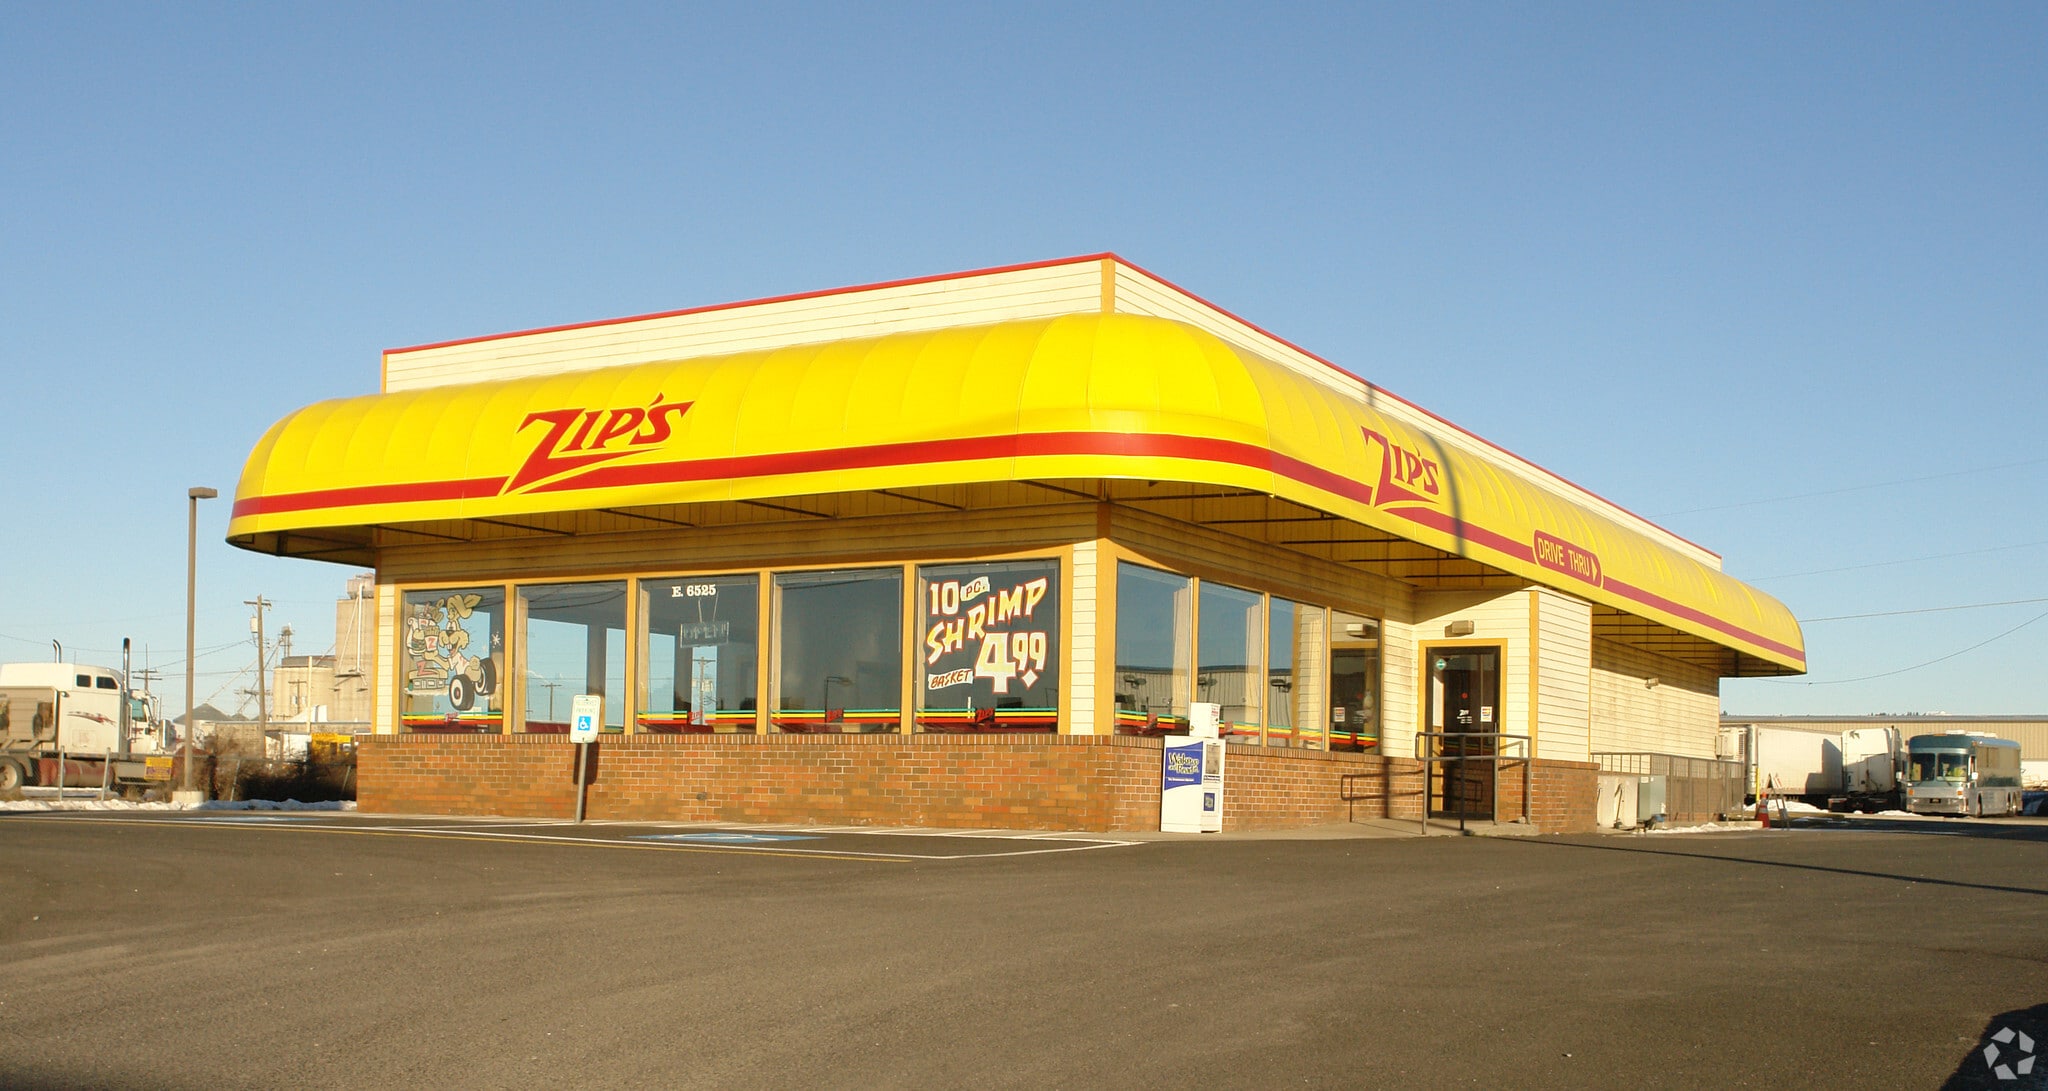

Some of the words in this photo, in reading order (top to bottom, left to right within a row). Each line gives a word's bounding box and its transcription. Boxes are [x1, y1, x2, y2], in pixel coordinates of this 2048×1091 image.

[1537, 537, 1565, 567] DRIVE
[1567, 549, 1590, 577] THRU
[671, 585, 684, 598] E.
[686, 584, 717, 597] 6525
[929, 580, 960, 616] 10
[965, 580, 987, 598] PC.
[926, 575, 1050, 667] SHRIMP
[930, 669, 972, 689] BASKET
